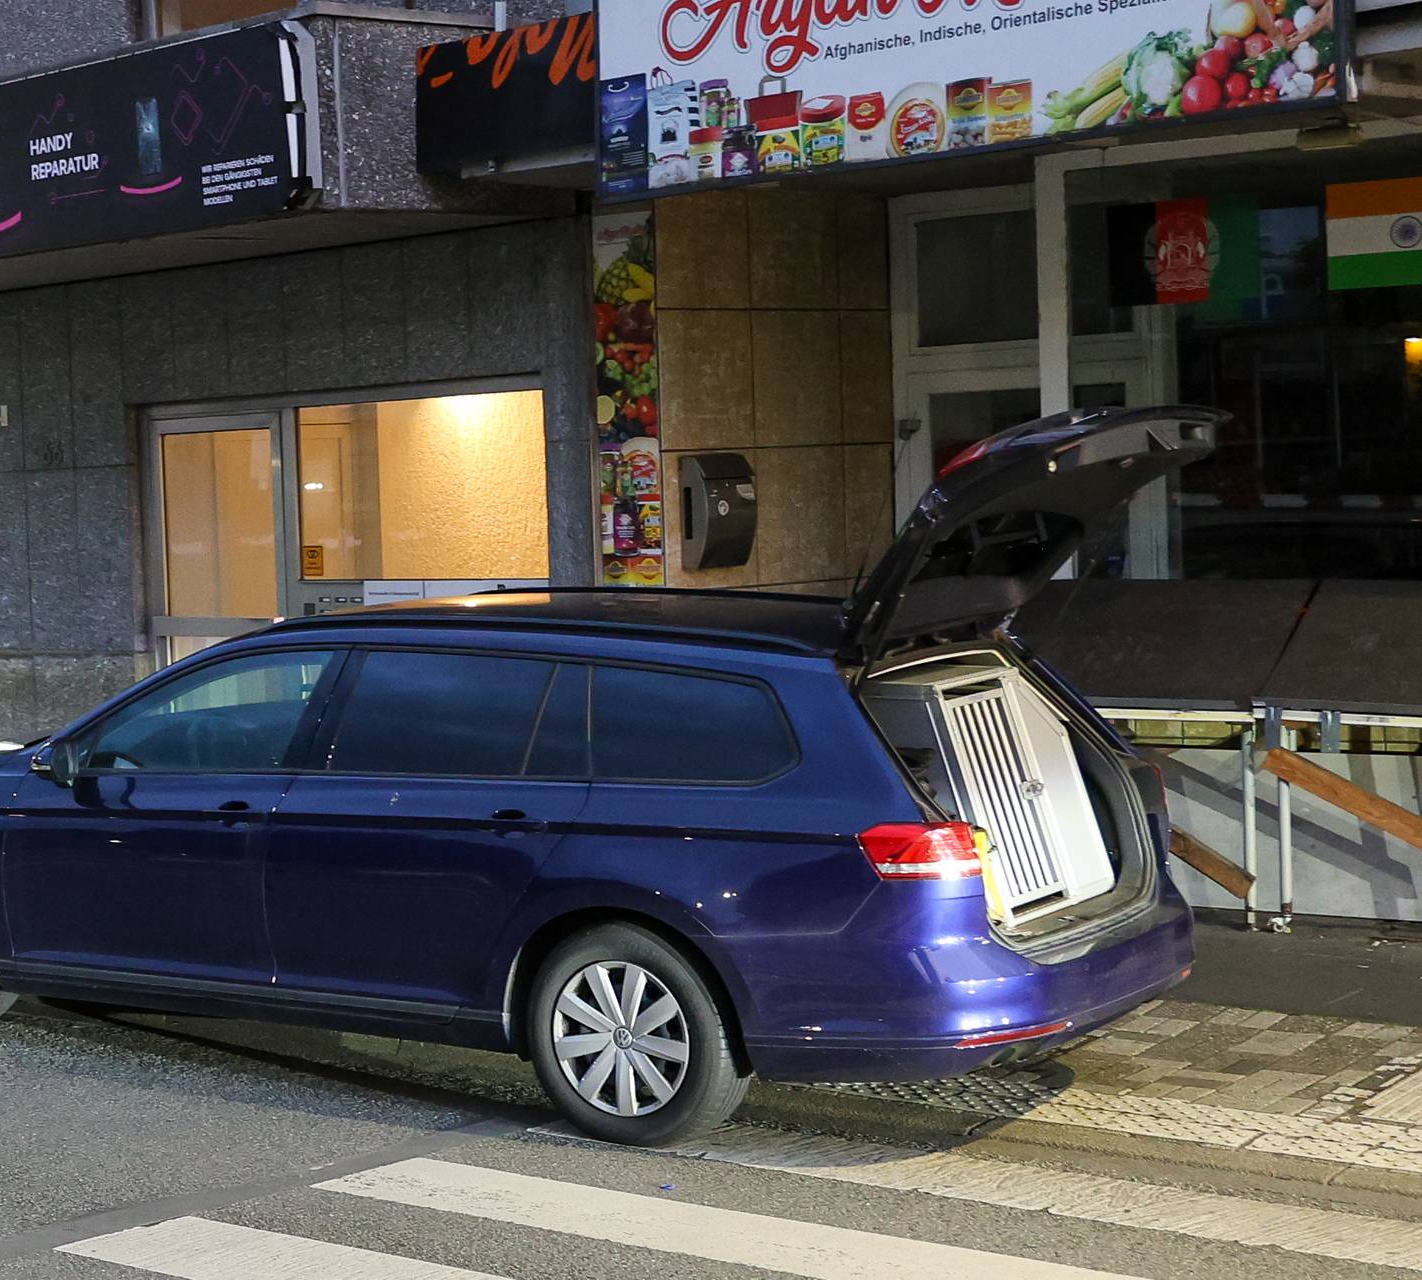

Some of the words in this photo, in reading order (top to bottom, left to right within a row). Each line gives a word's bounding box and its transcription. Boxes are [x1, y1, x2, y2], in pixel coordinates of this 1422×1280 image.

[823, 34, 916, 60] Afghanische,
[919, 20, 986, 43] Indische,
[990, 3, 1093, 31] Orientalische
[29, 132, 73, 156] HANDY
[30, 153, 99, 181] REPARATUR
[211, 174, 224, 183] DEN
[202, 182, 242, 195] SMARTPHONE
[243, 180, 257, 189] UND
[257, 176, 278, 187] TABLET
